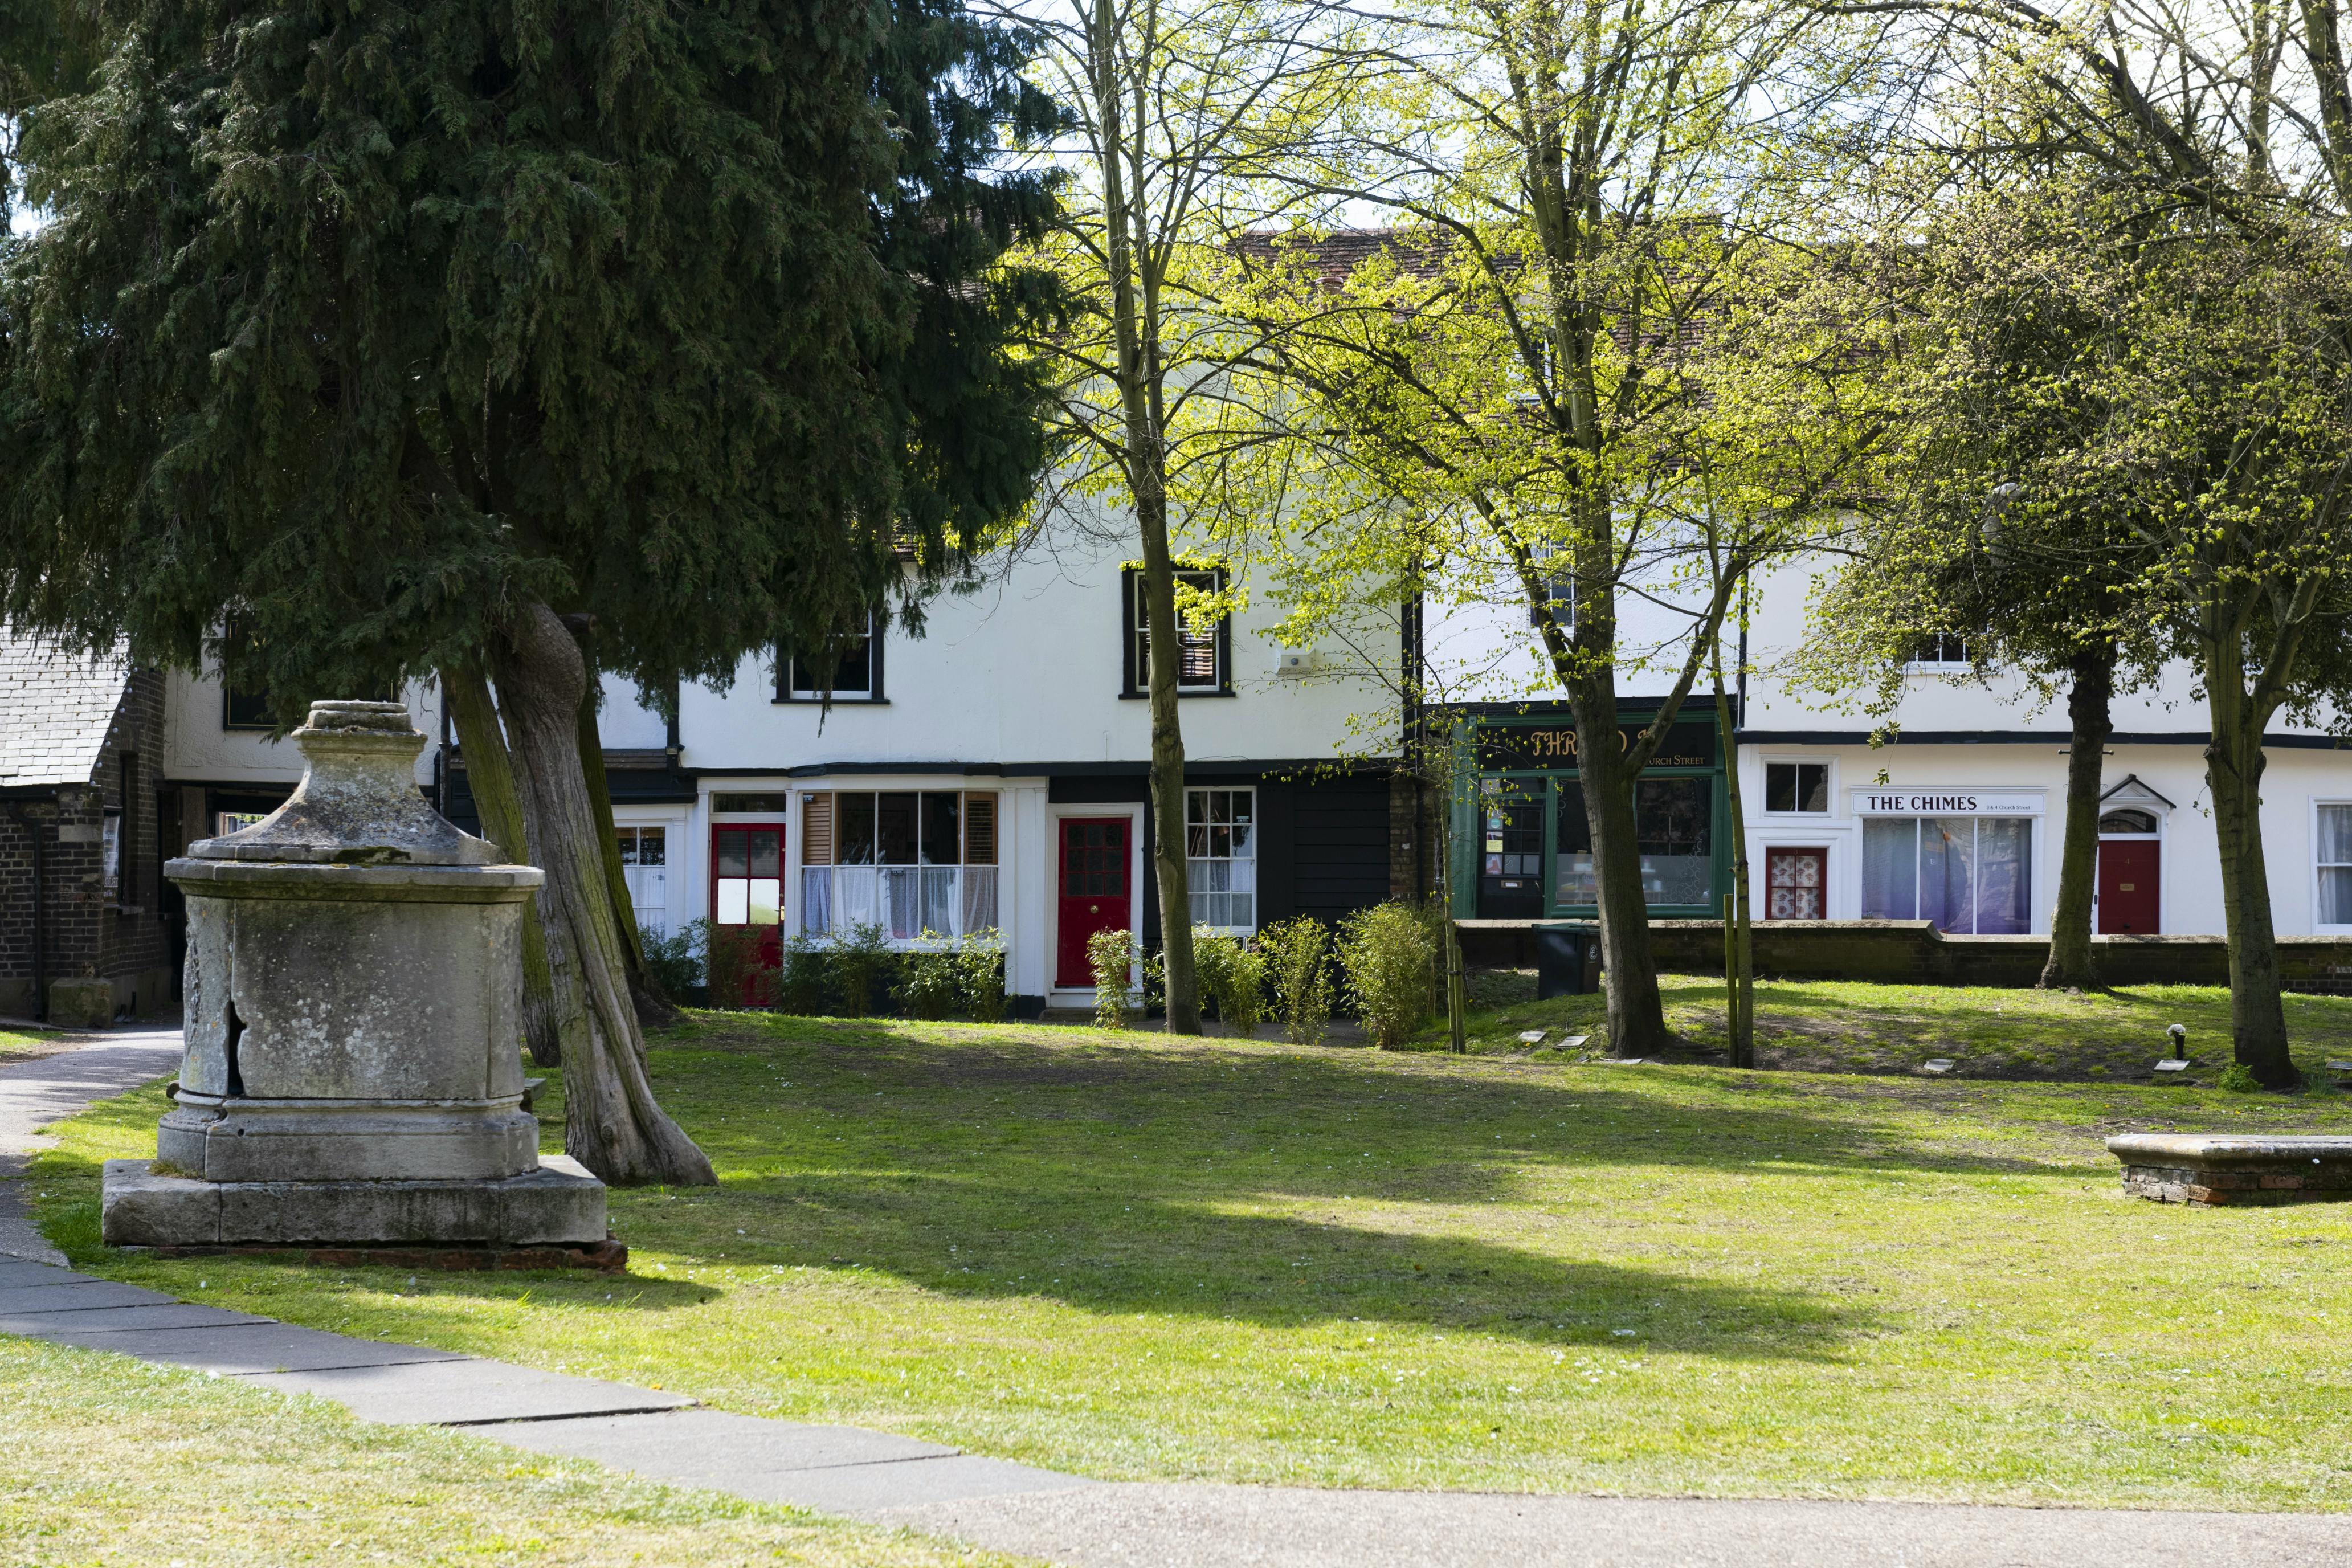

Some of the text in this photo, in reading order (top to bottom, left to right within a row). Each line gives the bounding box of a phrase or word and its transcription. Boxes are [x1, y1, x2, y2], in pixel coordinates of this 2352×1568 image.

[1673, 755, 1705, 765] STREET
[1867, 796, 1977, 811] THE CHIMES
